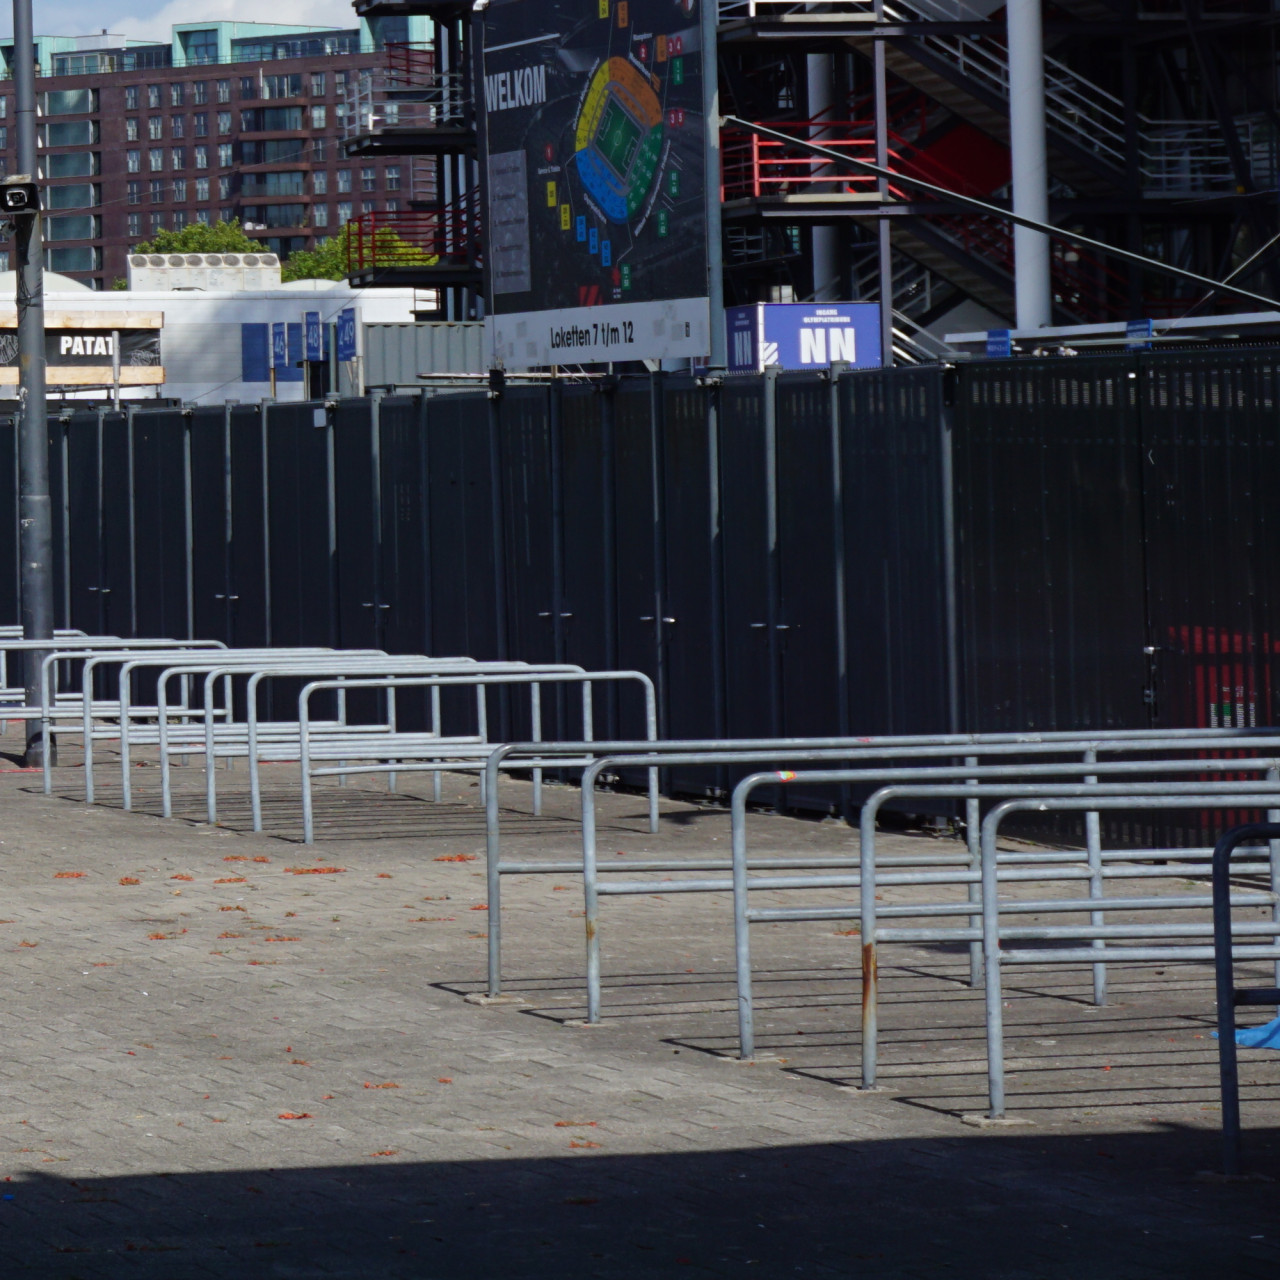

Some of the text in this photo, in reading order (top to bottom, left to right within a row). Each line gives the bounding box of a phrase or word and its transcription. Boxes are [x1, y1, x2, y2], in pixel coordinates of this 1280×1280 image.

[484, 64, 547, 113] WELKOM
[60, 336, 114, 355] PATAT
[274, 335, 285, 356] 46
[308, 325, 319, 348] 48
[344, 321, 354, 345] 49
[550, 320, 634, 349] Loketten 7 t/m 12
[800, 327, 856, 364] NN
[734, 330, 753, 366] NN
